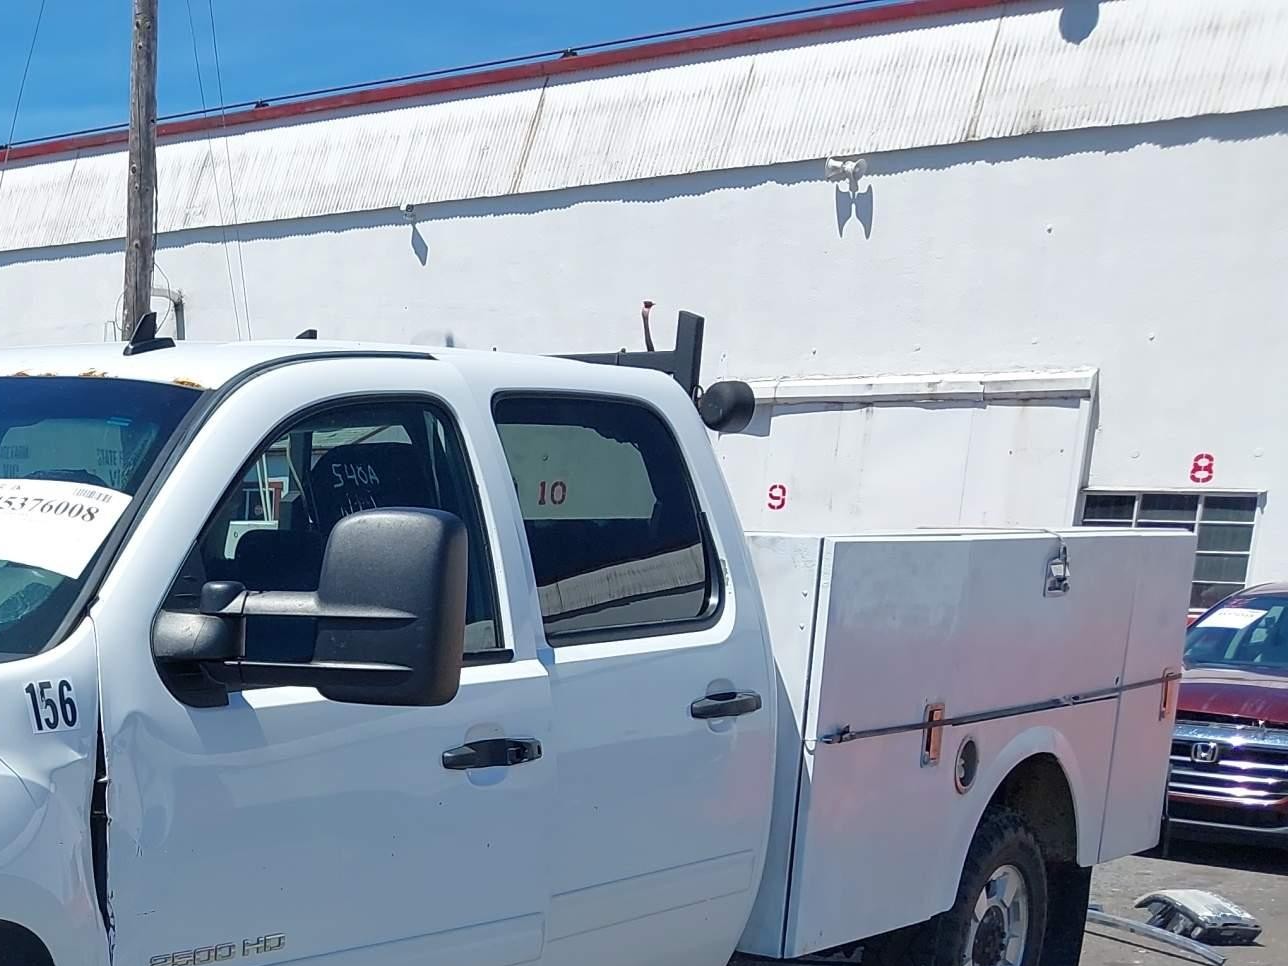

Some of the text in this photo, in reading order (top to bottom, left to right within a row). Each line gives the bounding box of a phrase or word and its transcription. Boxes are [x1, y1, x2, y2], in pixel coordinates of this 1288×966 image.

[1190, 453, 1214, 483] 8
[538, 481, 567, 505] 10
[768, 484, 786, 510] 9
[25, 680, 77, 731] 156
[242, 932, 286, 957] HD
